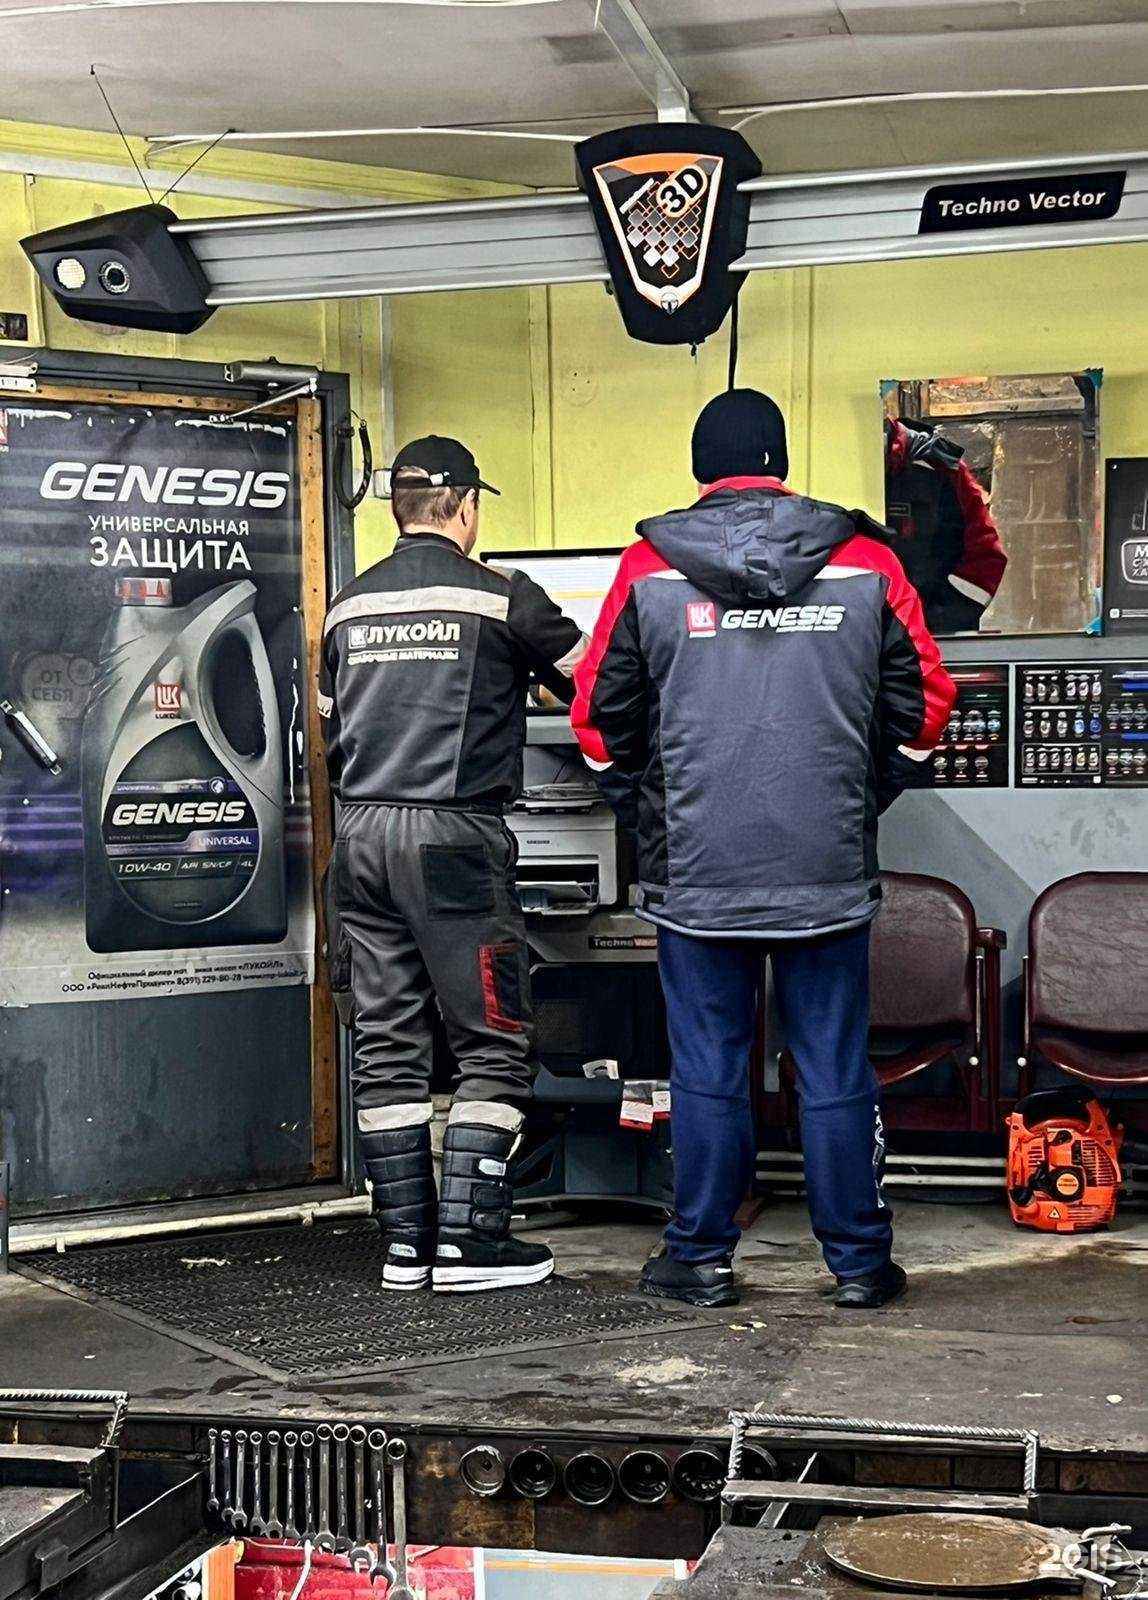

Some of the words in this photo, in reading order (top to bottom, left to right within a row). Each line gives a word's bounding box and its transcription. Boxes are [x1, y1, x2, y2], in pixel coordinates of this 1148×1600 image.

[659, 167, 704, 214] 3D
[938, 196, 1020, 217] Techno
[1029, 189, 1106, 210] Vector
[40, 461, 290, 509] GENESIS
[88, 514, 250, 536] УНИВЕРСАЛЬНАЯ
[89, 536, 252, 573] ЗАЩИТА
[721, 605, 845, 630] GENESIS
[366, 619, 461, 644] ЛУКОЙЛ
[112, 801, 247, 826] GENESIS
[118, 863, 171, 874] 10W-40
[62, 983, 85, 992] ООО
